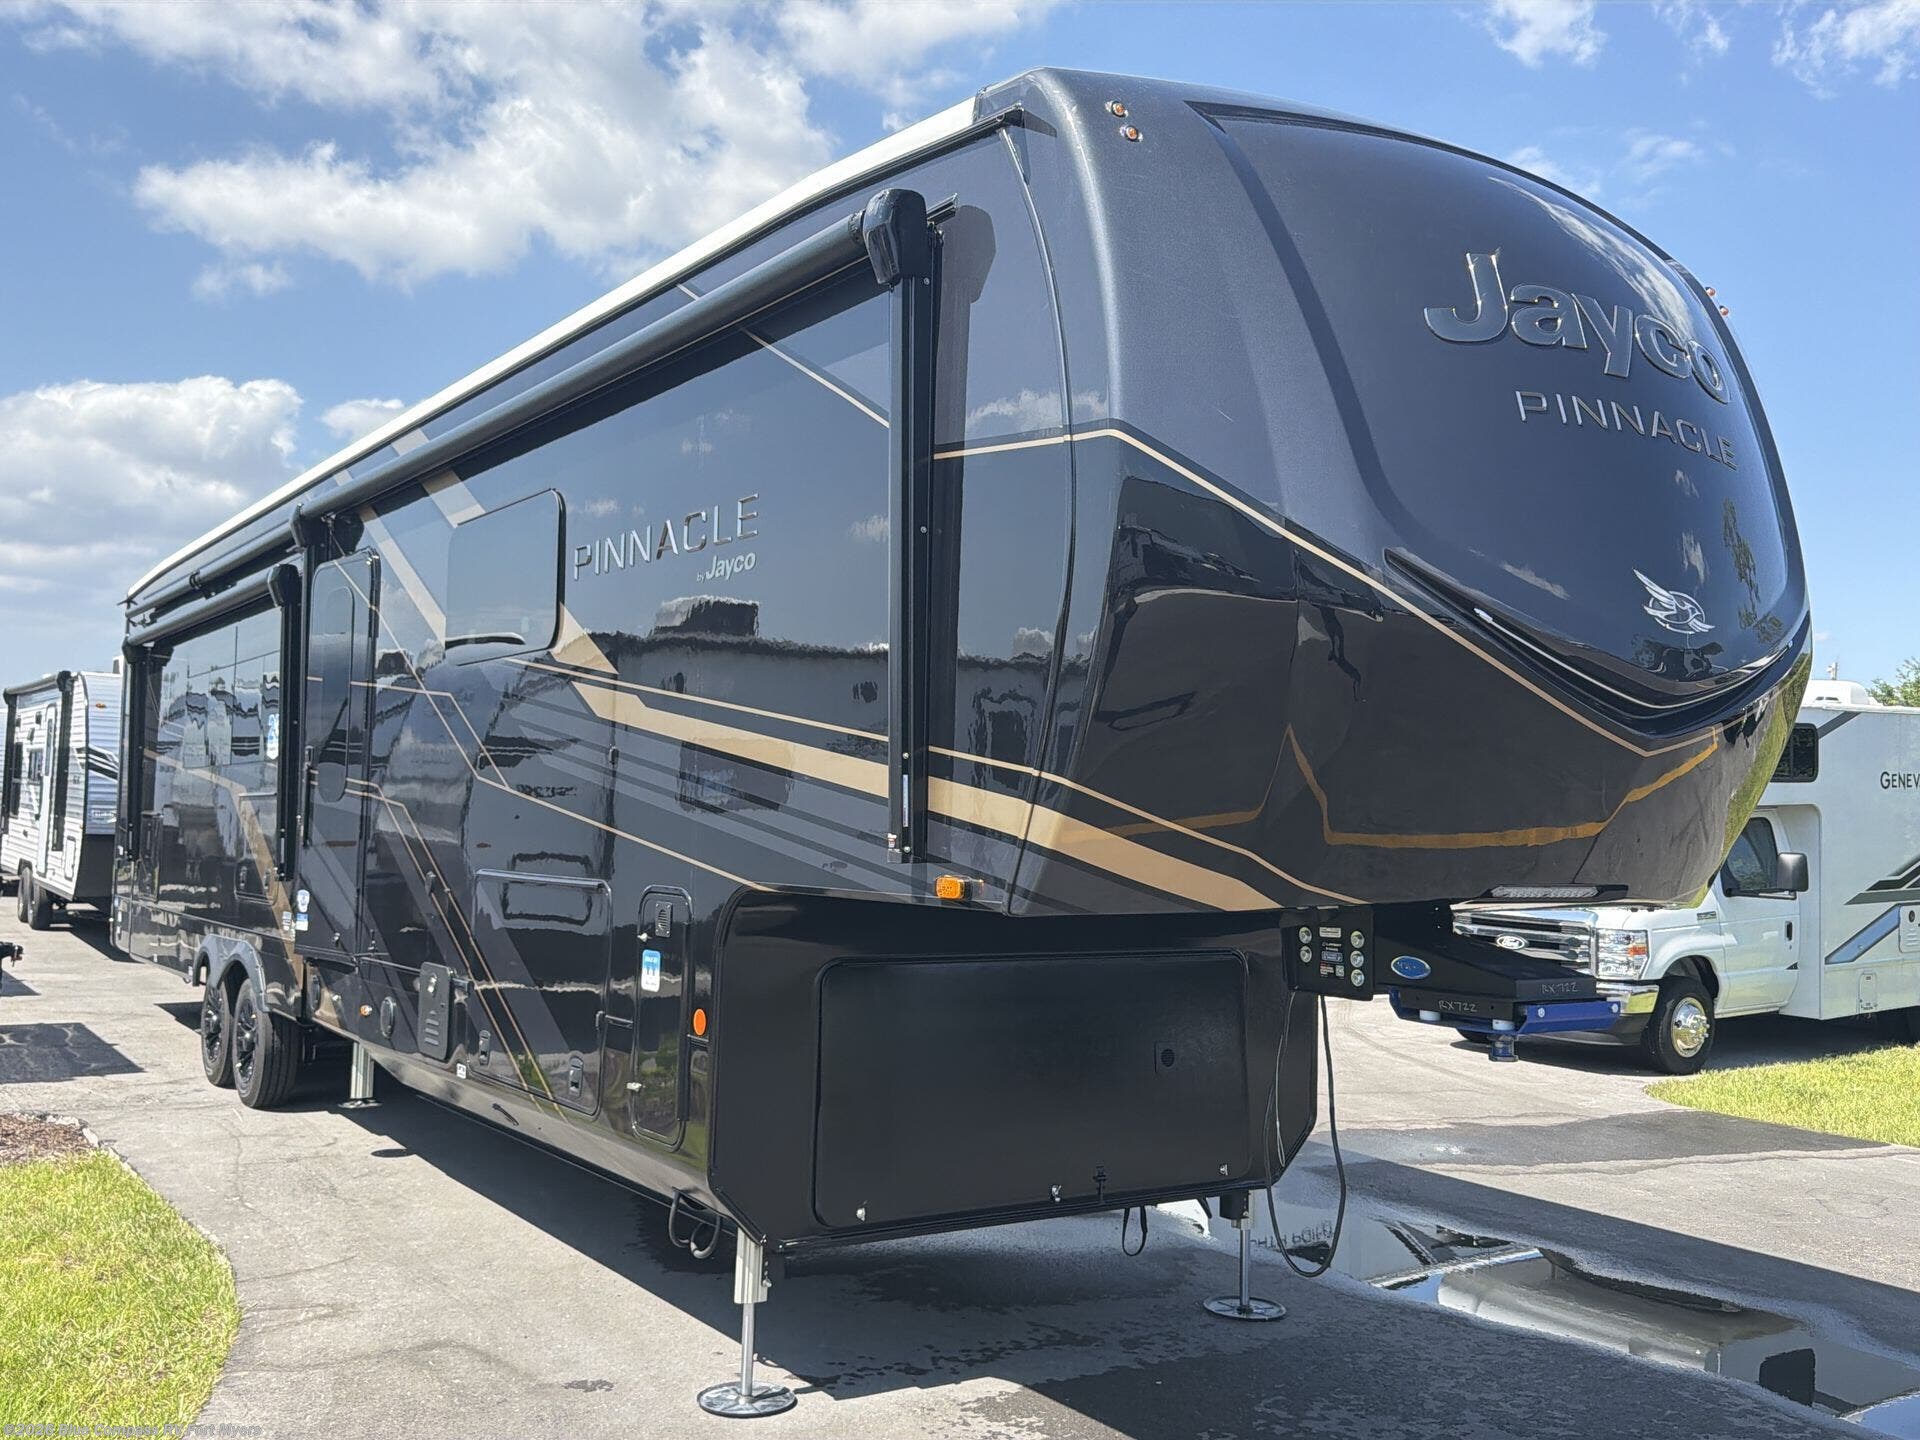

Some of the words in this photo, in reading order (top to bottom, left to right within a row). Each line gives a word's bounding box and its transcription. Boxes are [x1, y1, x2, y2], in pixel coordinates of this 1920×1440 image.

[1424, 250, 1731, 404] Jayco
[1515, 390, 1738, 470] PINNACLE
[573, 493, 759, 581] PINNACLE
[706, 552, 756, 580] Jayco
[1880, 771, 1920, 790] GENEV
[1438, 1000, 1478, 1013] RX722
